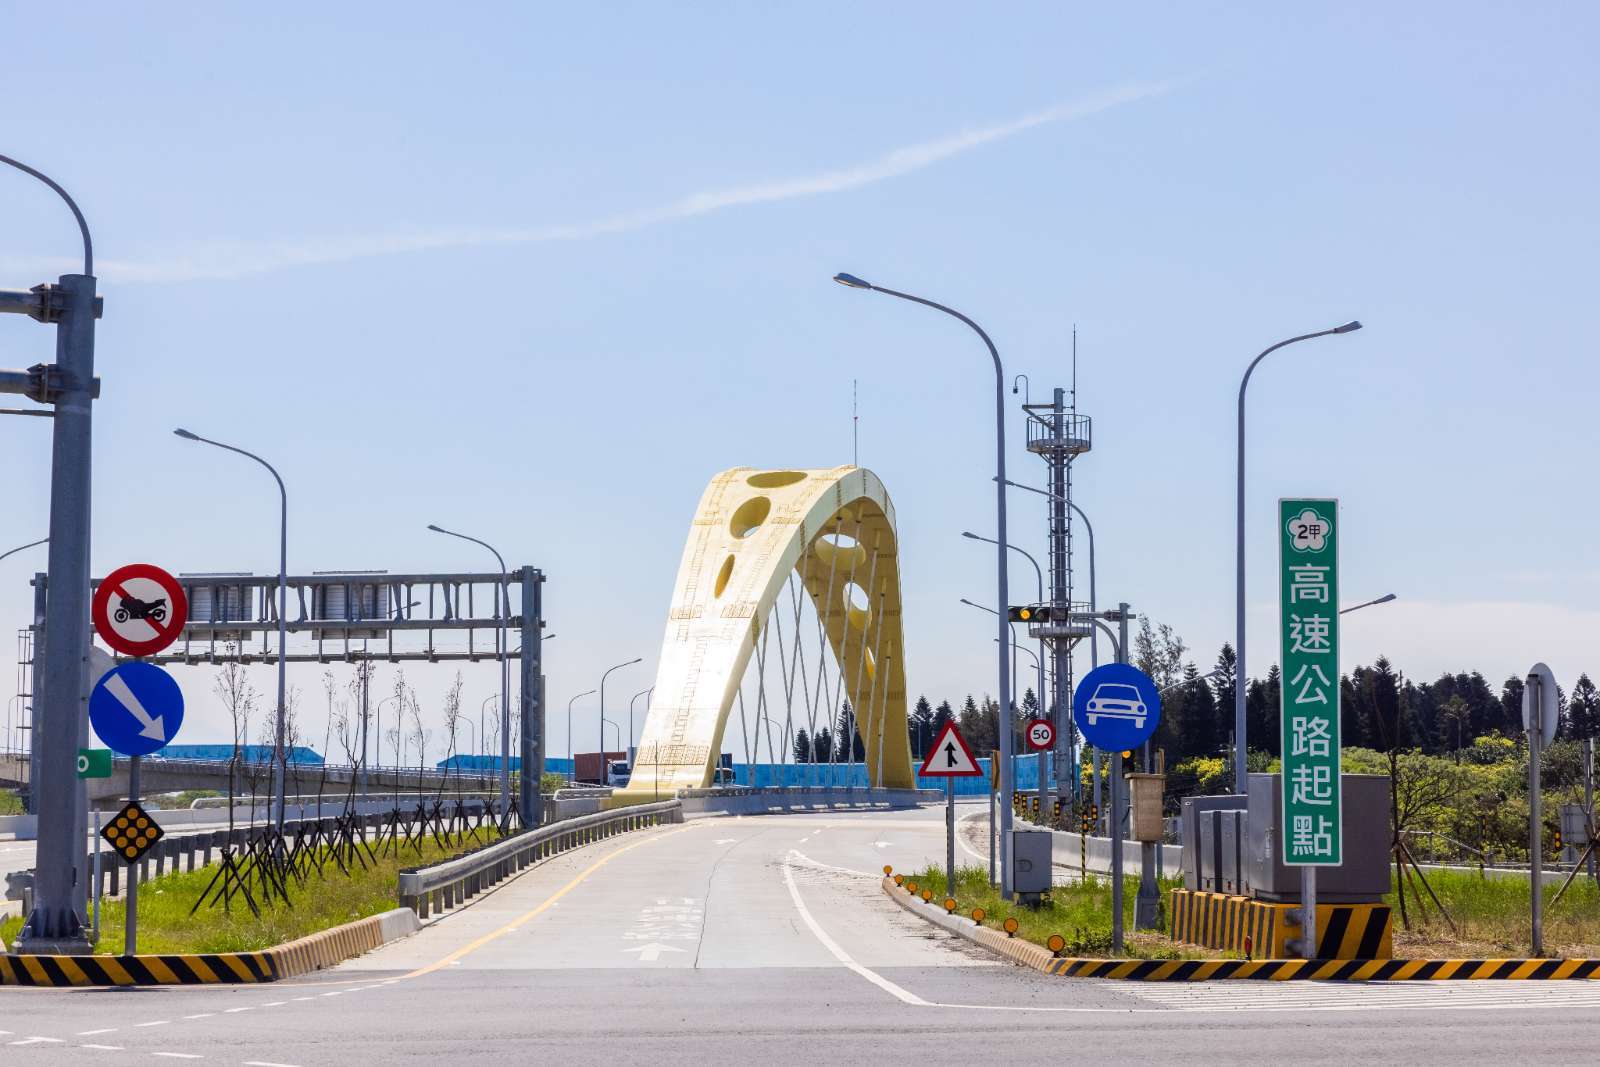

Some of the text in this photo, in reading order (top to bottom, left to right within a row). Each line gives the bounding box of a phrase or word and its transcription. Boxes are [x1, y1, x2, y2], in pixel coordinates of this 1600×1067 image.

[1297, 524, 1321, 540] 2甲
[1288, 562, 1333, 857] 高速公路起點
[1033, 729, 1049, 740] 50
